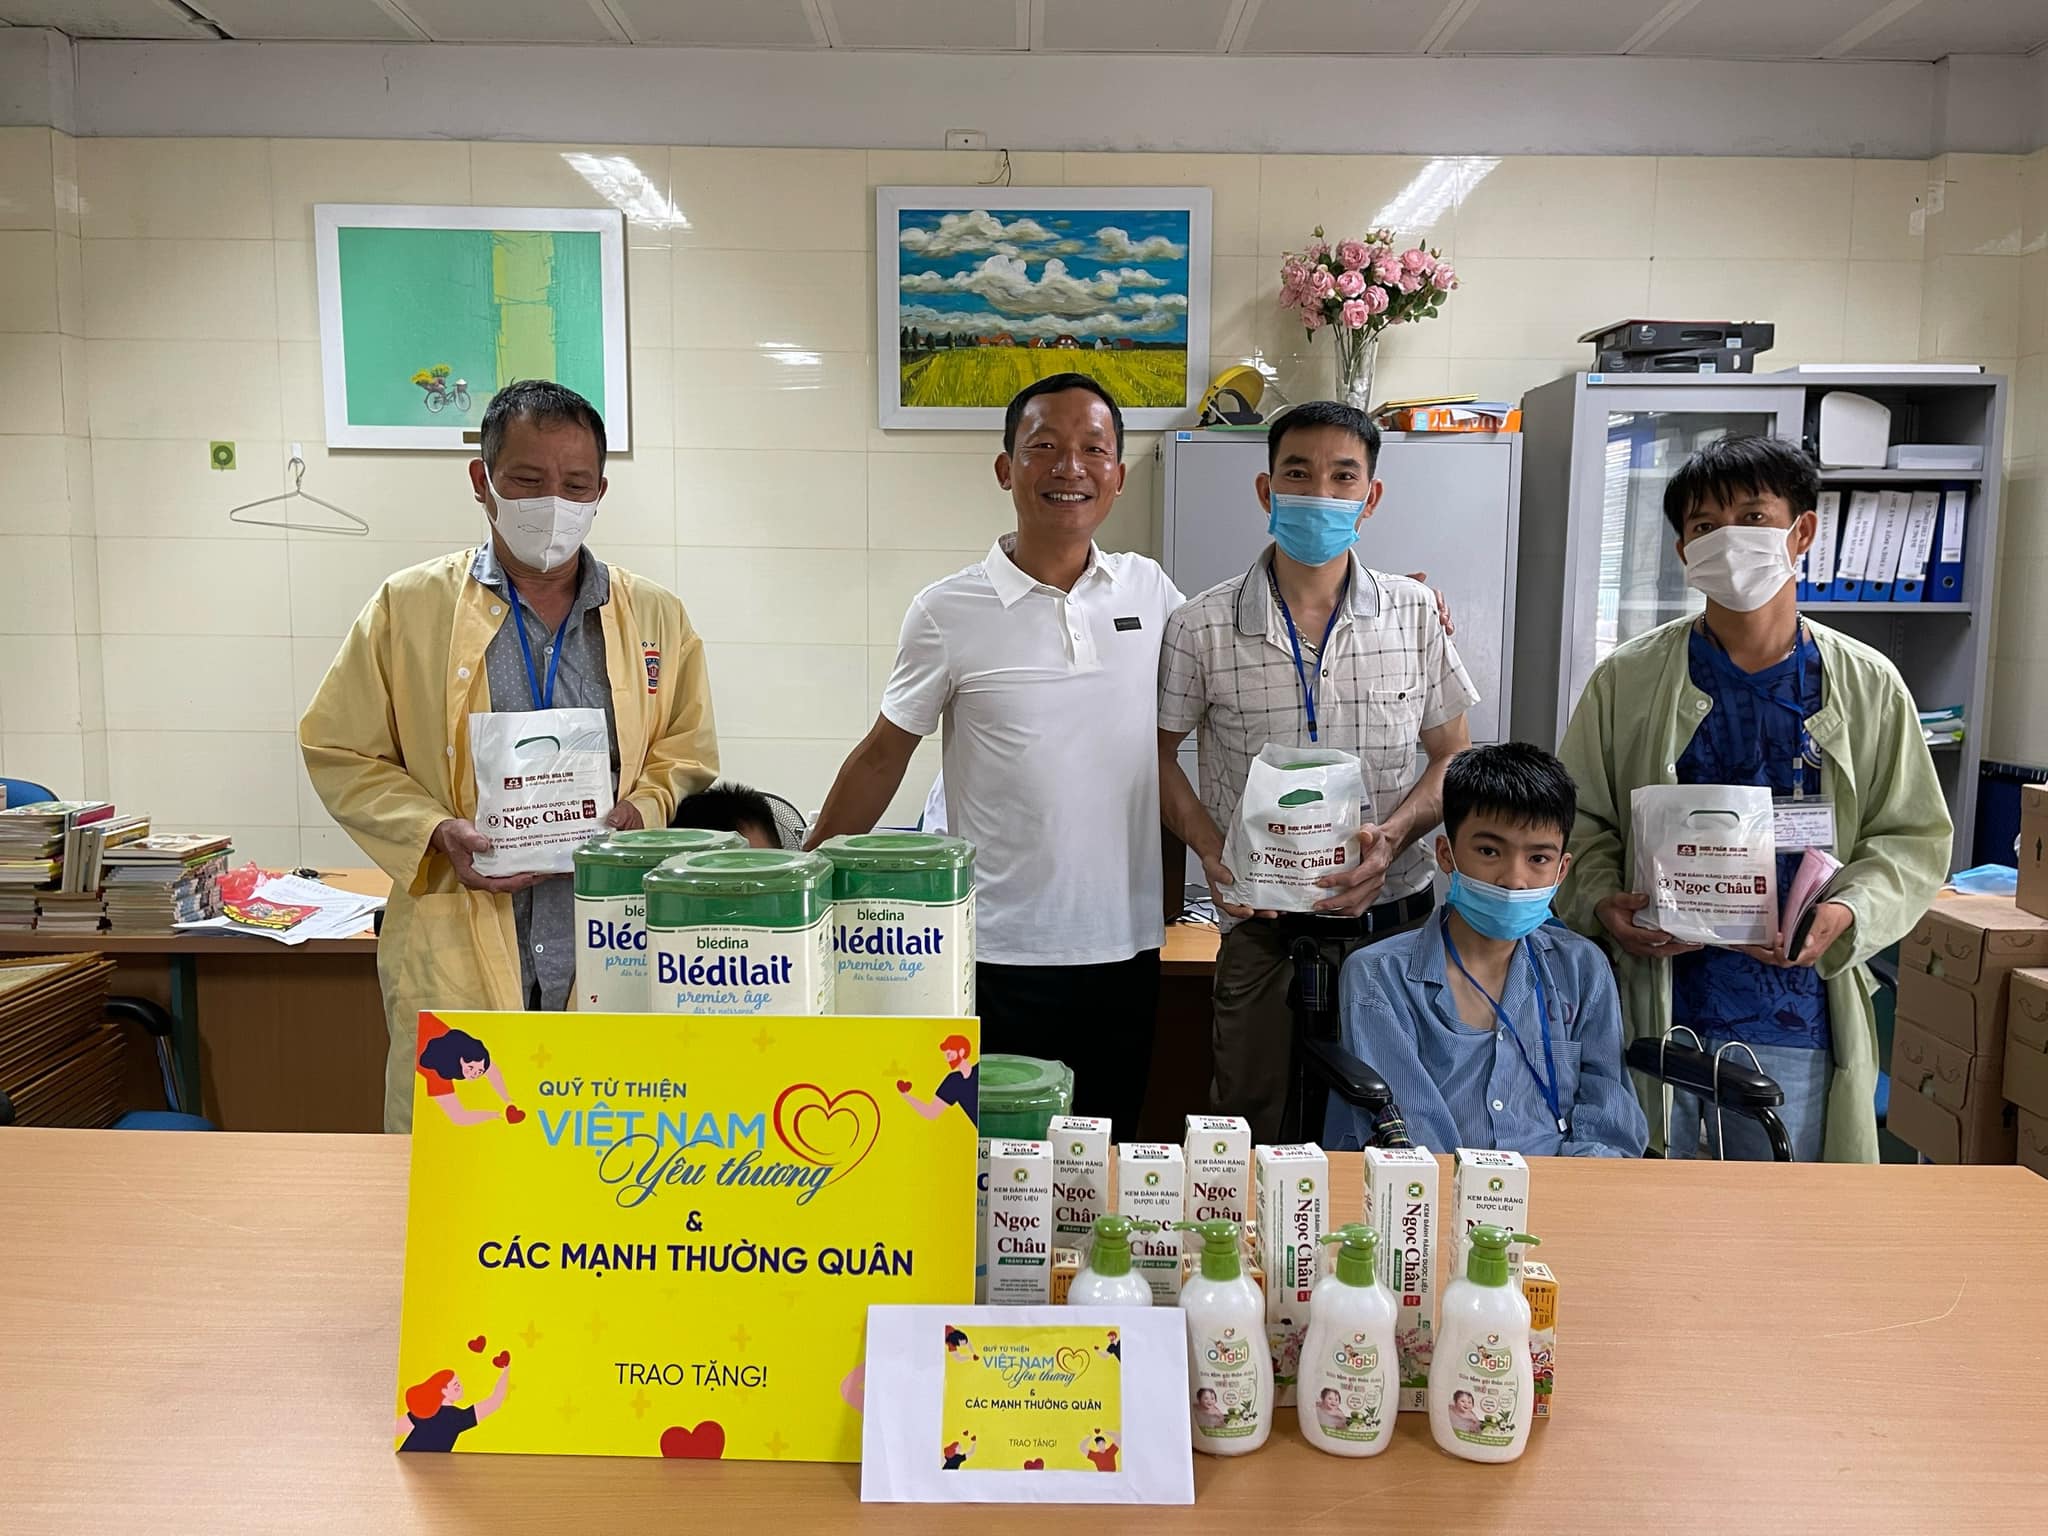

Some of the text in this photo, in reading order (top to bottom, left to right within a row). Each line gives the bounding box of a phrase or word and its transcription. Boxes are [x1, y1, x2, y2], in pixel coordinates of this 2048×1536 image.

[502, 815, 539, 830] Ngọc
[542, 808, 581, 823] Châu
[1264, 853, 1332, 869] Ngọc Châu
[1674, 879, 1711, 895] Ngọc
[1715, 881, 1752, 894] Châu
[605, 956, 647, 970] premi
[658, 952, 792, 986] Blédilait
[838, 959, 924, 977] premier âge
[677, 990, 772, 1010] premier âge
[539, 1077, 687, 1102] QUỸ TỪ THIỆN
[537, 1100, 765, 1157] VIỆT NAM
[599, 1133, 833, 1208] Yêu thương
[1052, 1182, 1096, 1202] Ngọc
[1193, 1182, 1237, 1201] Ngọc
[686, 1210, 703, 1232] &
[994, 1211, 1040, 1231] Ngọc
[1196, 1206, 1242, 1223] Châu
[998, 1236, 1046, 1254] Châu
[1130, 1240, 1177, 1257] Châu
[1294, 1199, 1313, 1288] Ngọc Châu
[1402, 1203, 1422, 1292] Ngọc Châu
[478, 1235, 913, 1278] CÁC MẠNH THƯỜNG QUÂN
[983, 1353, 1054, 1371] VIỆT NAM
[1208, 1349, 1247, 1364] Ongbi
[1336, 1352, 1376, 1369] Ongbi
[1469, 1353, 1509, 1370] Ongbi
[614, 1360, 768, 1392] TRAO TẶNG!
[965, 1397, 1102, 1412] CÁC MẠNH THƯỜNG QUÂN
[1009, 1439, 1031, 1447] TRAO
